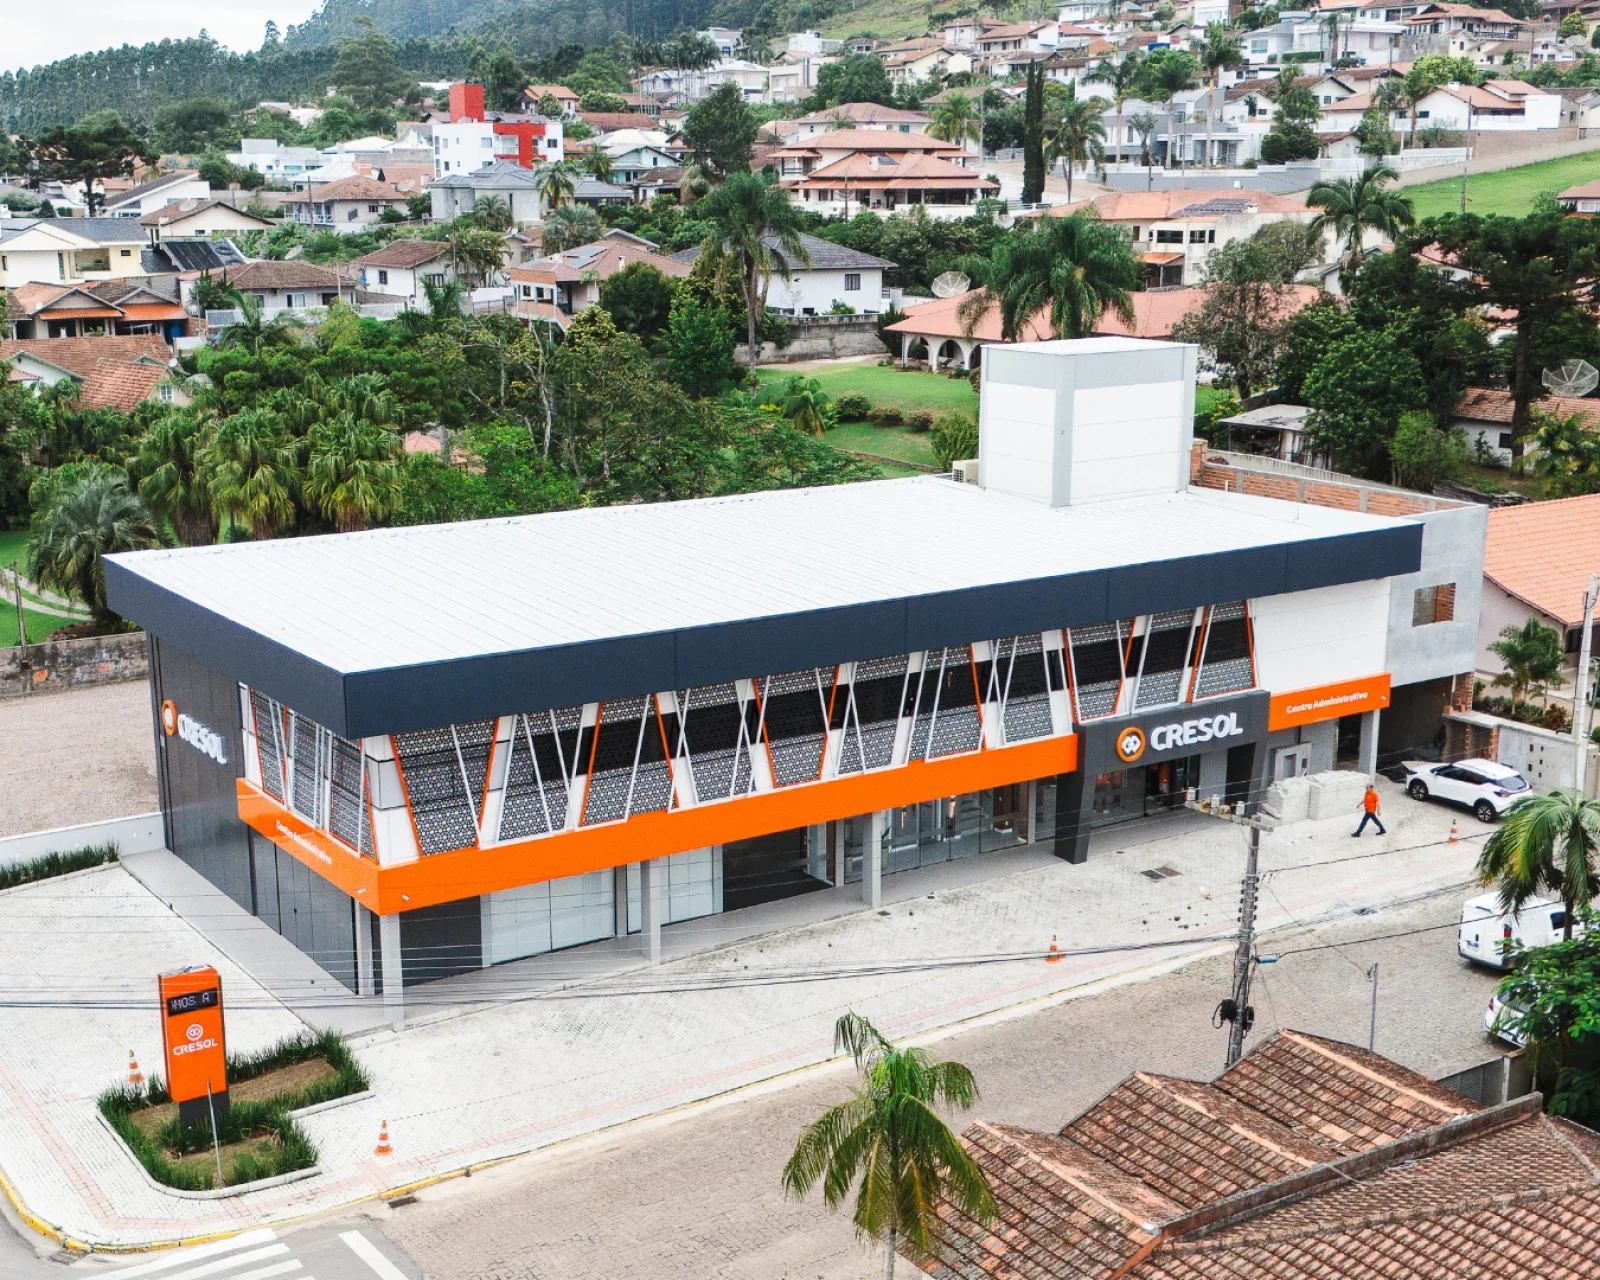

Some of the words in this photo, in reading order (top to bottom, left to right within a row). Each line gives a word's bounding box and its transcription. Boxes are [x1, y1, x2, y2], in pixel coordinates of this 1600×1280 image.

[1286, 702, 1312, 714] Centro
[1313, 691, 1369, 709] Administrativo
[177, 713, 227, 765] CRESOL
[1150, 712, 1243, 751] CRESOL
[173, 1038, 218, 1056] CRESOL
